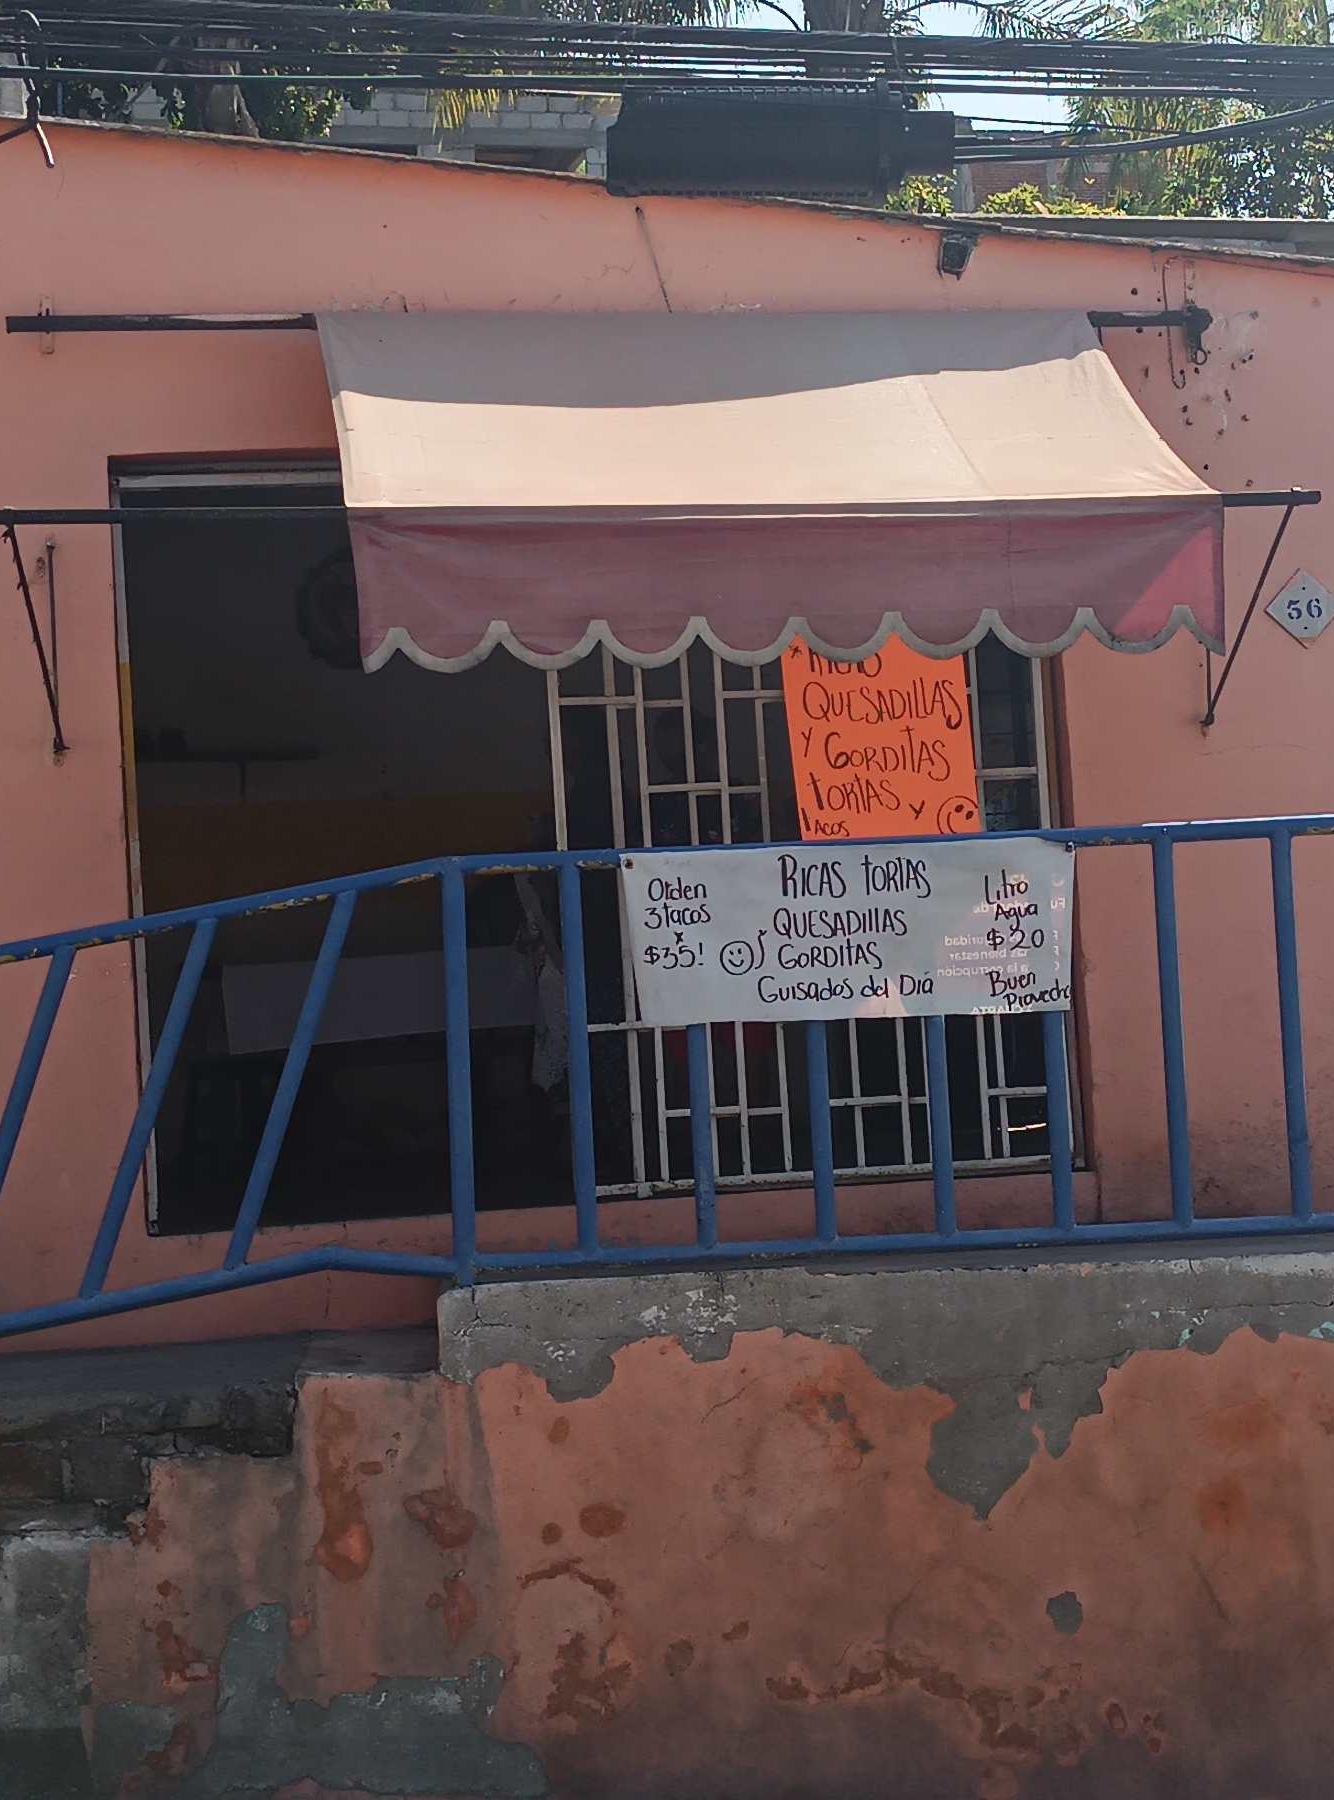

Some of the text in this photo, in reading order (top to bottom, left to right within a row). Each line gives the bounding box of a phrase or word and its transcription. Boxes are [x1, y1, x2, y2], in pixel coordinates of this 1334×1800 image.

[1286, 597, 1323, 620] 56
[802, 677, 963, 730] QUESADILLAS
[778, 853, 847, 899] RICAS
[994, 903, 1039, 933] Agua
[860, 974, 890, 999] del
[984, 970, 1037, 998] Buen
